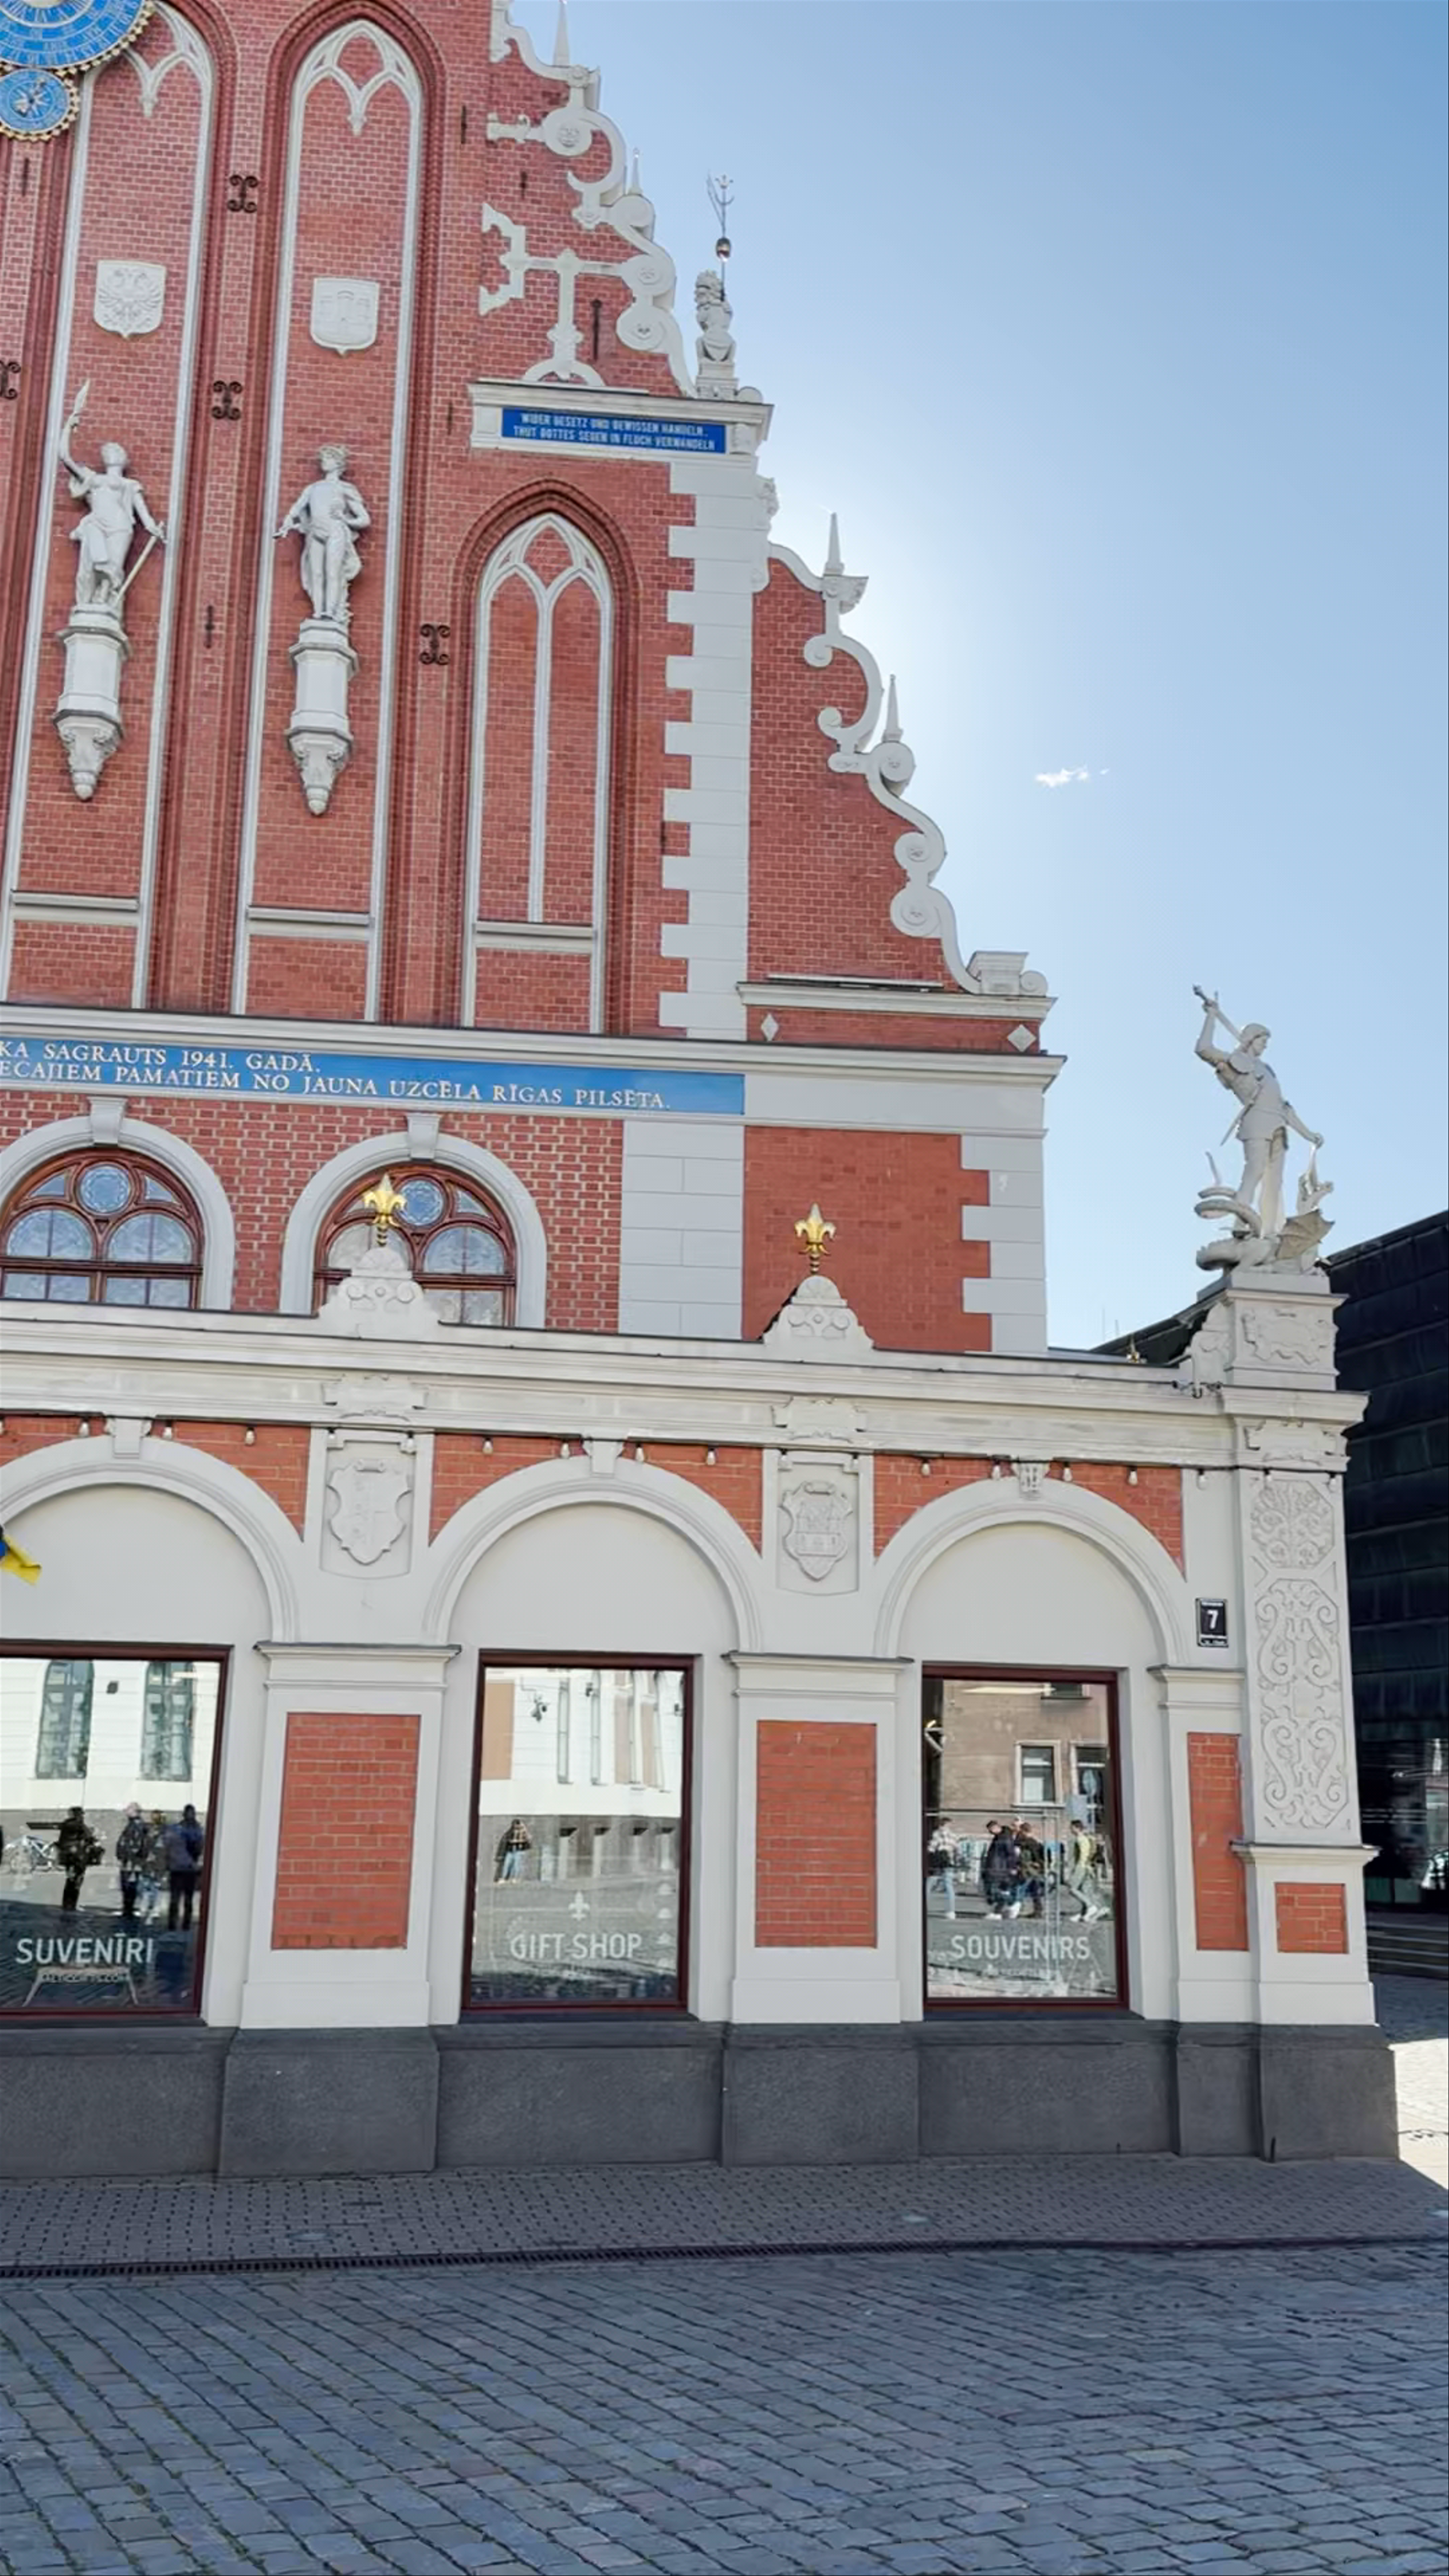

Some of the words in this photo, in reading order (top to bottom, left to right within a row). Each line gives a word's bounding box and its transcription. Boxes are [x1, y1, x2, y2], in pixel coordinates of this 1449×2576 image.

[521, 412, 551, 425] WIDER
[554, 415, 587, 428] GESETZ
[591, 418, 610, 429] UND
[613, 419, 659, 433] GEWISSEN
[540, 428, 575, 440] GOTTES
[610, 433, 620, 444] IN
[623, 434, 653, 446] FLUCH
[43, 1043, 167, 1065] SAGRAUTS
[182, 1050, 234, 1069] 1941.
[115, 1065, 240, 1088] PAMATIEM
[253, 1073, 290, 1091] NO
[303, 1075, 377, 1095] JAUNA
[1207, 1609, 1218, 1629] 7
[15, 1932, 153, 1964] SUVENĪRI
[510, 1933, 565, 1959] GIFT
[571, 1932, 642, 1959] SHOP
[951, 1935, 1091, 1960] SOUVENIRS
